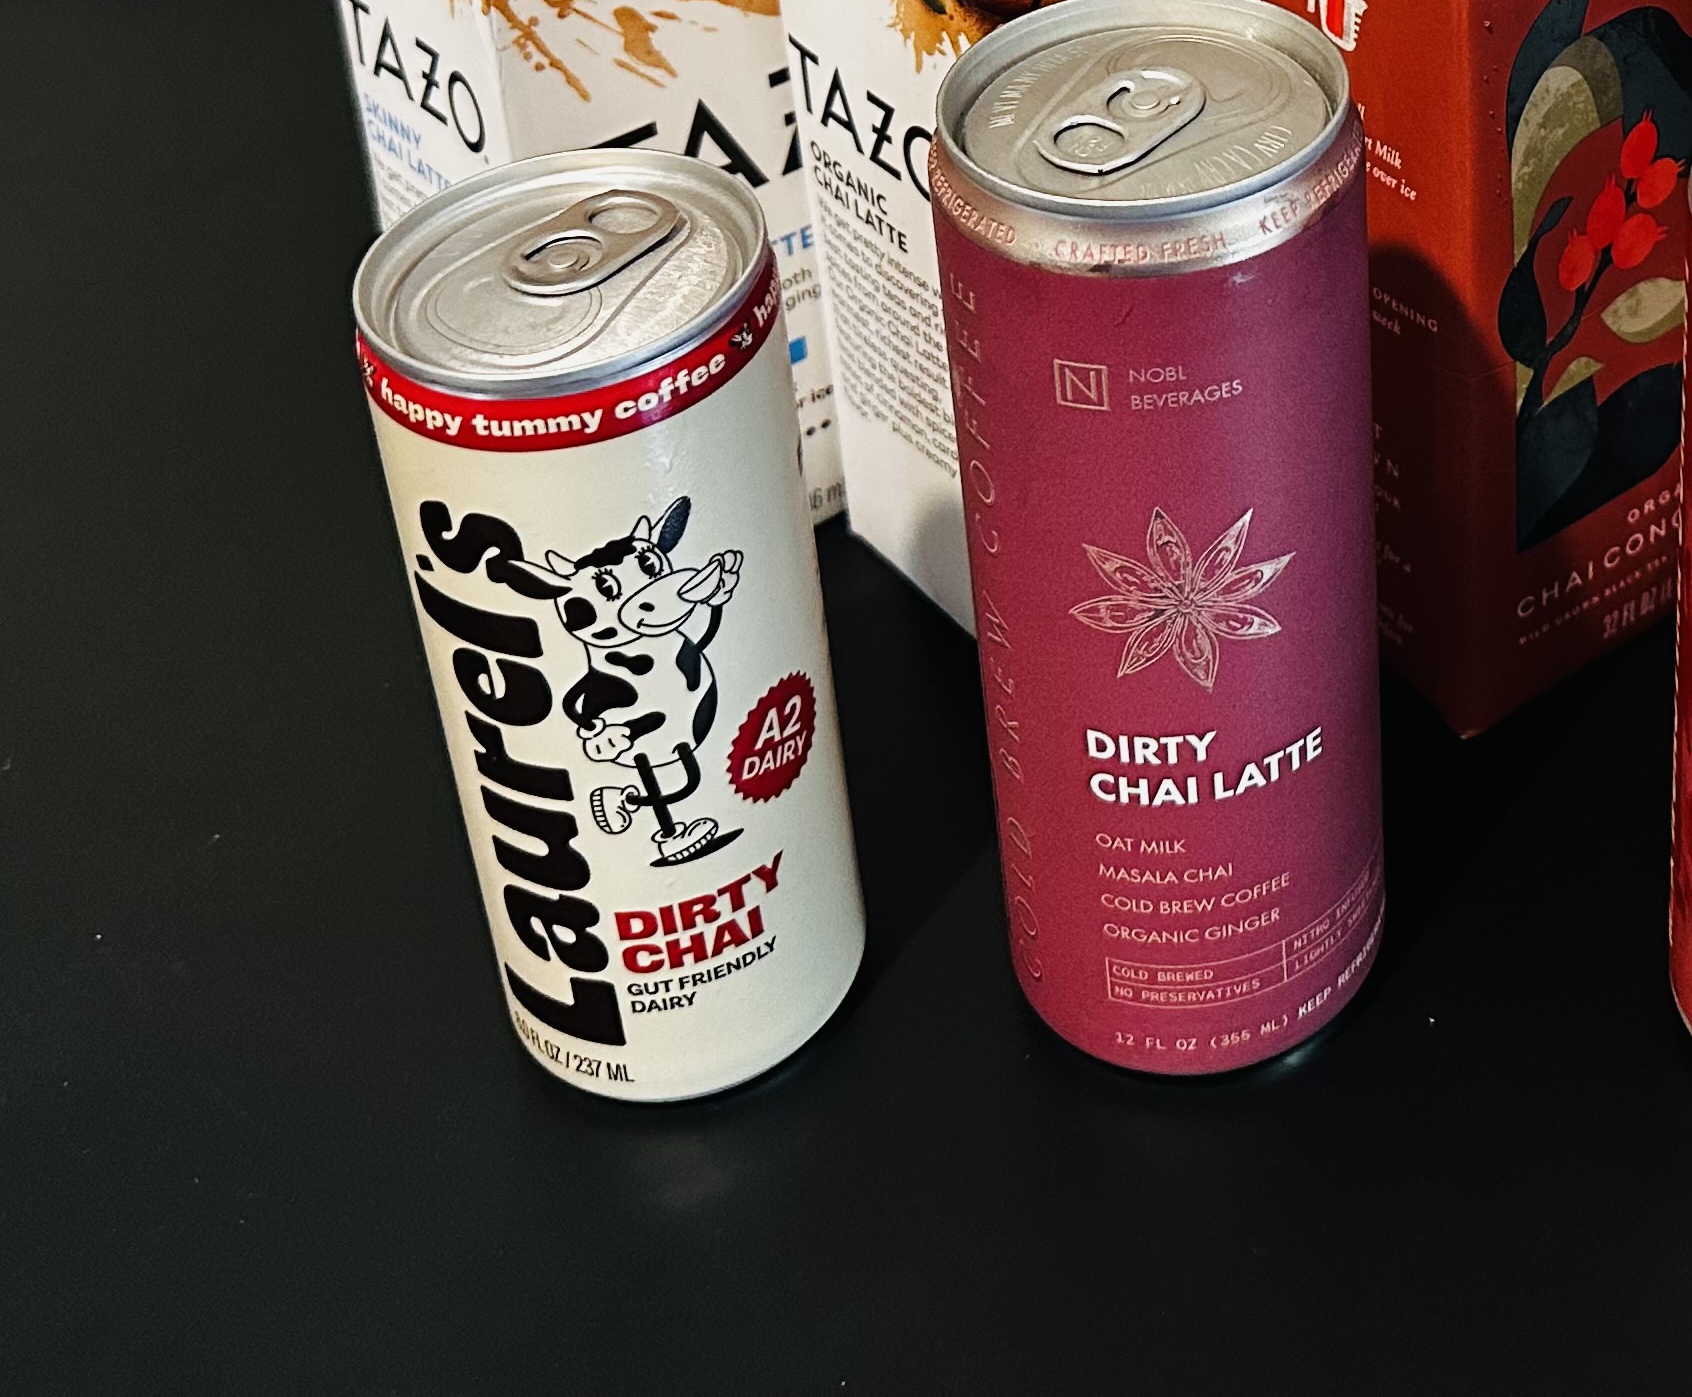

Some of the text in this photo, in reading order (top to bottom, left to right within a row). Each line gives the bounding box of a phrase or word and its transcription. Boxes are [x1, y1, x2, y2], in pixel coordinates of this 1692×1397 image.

[364, 93, 421, 148] SKINNY
[368, 119, 404, 161] CHAI
[811, 141, 887, 216] ORGANIC
[814, 167, 908, 253] CHAI LATTE
[1053, 201, 1300, 265] CRAFTED FRESH KEEP
[380, 352, 726, 437] happy tummy coffee
[1128, 366, 1187, 384] NOBL
[1130, 379, 1243, 411] BEVERAGES
[757, 695, 803, 741] A2
[741, 733, 807, 781] DAIRY
[1086, 728, 1217, 765] DIRTY
[1089, 726, 1323, 807] CHAI LATTE
[414, 499, 626, 1048] Laurel's
[1095, 833, 1186, 854] OAT MILK
[614, 849, 784, 941] DIRTY
[1098, 862, 1233, 884] MASALA CHAI
[1100, 871, 1290, 915] COLD BREW COFFEE
[622, 904, 765, 974] CHAI
[1103, 907, 1281, 944] ORGANIC GINGER
[627, 936, 777, 997] GUT FRIENDLY
[1112, 965, 1214, 983] COLD BREWED
[631, 991, 697, 1015] DAIRY
[1114, 977, 1262, 1003] NO PRESERVATIVES
[1115, 1031, 1135, 1046] 12
[1145, 1037, 1167, 1051] FL
[1175, 1038, 1198, 1051] OZ
[1259, 1013, 1289, 1036] ML)
[1297, 986, 1332, 1019] KEEP
[573, 1053, 601, 1080] 237
[606, 1060, 635, 1084] ML
